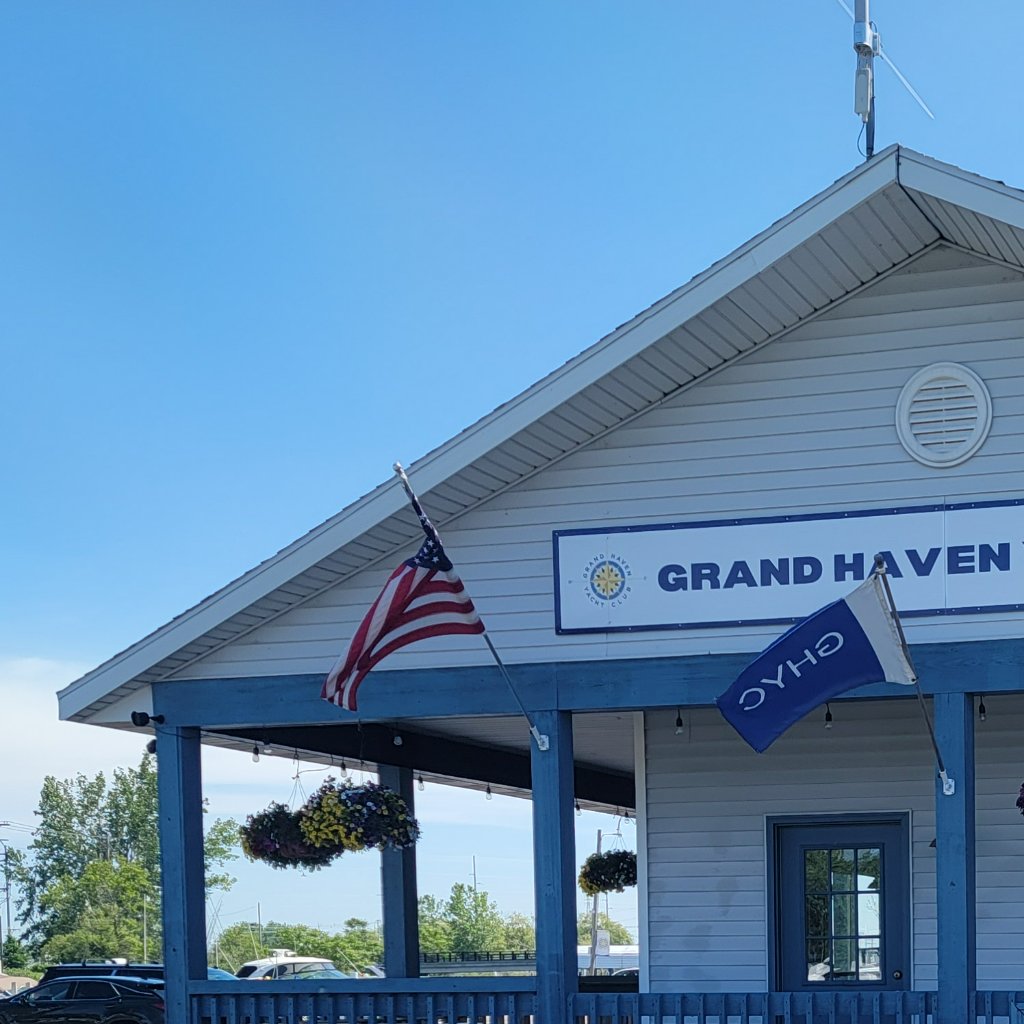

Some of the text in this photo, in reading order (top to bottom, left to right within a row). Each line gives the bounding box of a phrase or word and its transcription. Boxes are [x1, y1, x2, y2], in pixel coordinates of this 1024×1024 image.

[583, 553, 632, 579] GRAND HAVEN
[658, 556, 823, 592] GRAND
[834, 543, 1011, 582] HAVEN
[584, 586, 632, 608] YACHT CLUB
